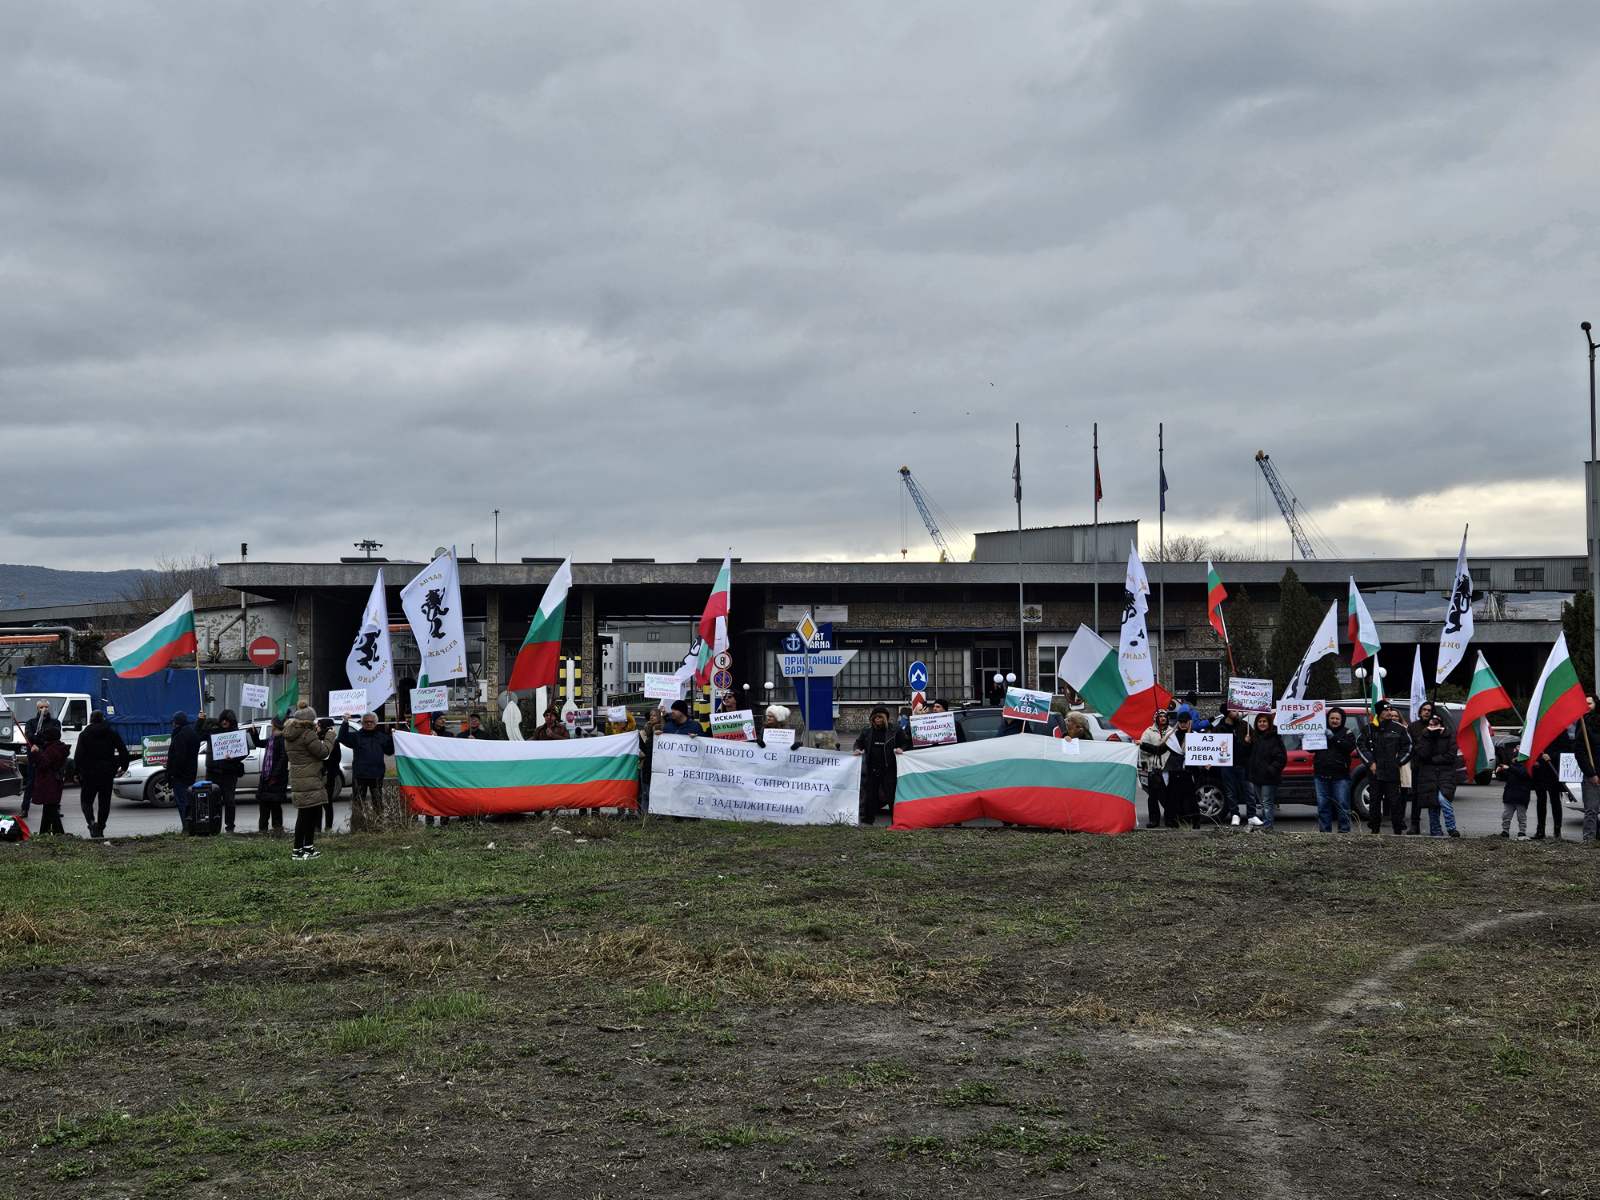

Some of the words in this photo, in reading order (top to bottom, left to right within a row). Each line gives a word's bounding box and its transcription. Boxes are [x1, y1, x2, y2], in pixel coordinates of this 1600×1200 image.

[809, 640, 831, 649] ARNA
[784, 655, 842, 665] ПРИТАНИЩЕ
[714, 713, 743, 722] ИСКАМЕ
[1280, 723, 1324, 731] СВОБОДА
[657, 740, 698, 753] КОГАТО
[705, 745, 755, 758] ПРАВОТО
[764, 752, 778, 761] СЕ
[789, 754, 840, 767] ПРЕВЪРНЕ
[667, 769, 674, 777] В
[754, 778, 831, 793] СЪПРОТИВАТА
[697, 797, 704, 805] Е
[711, 798, 804, 815] ЗАДЪЛЖИТЕЛНА!
